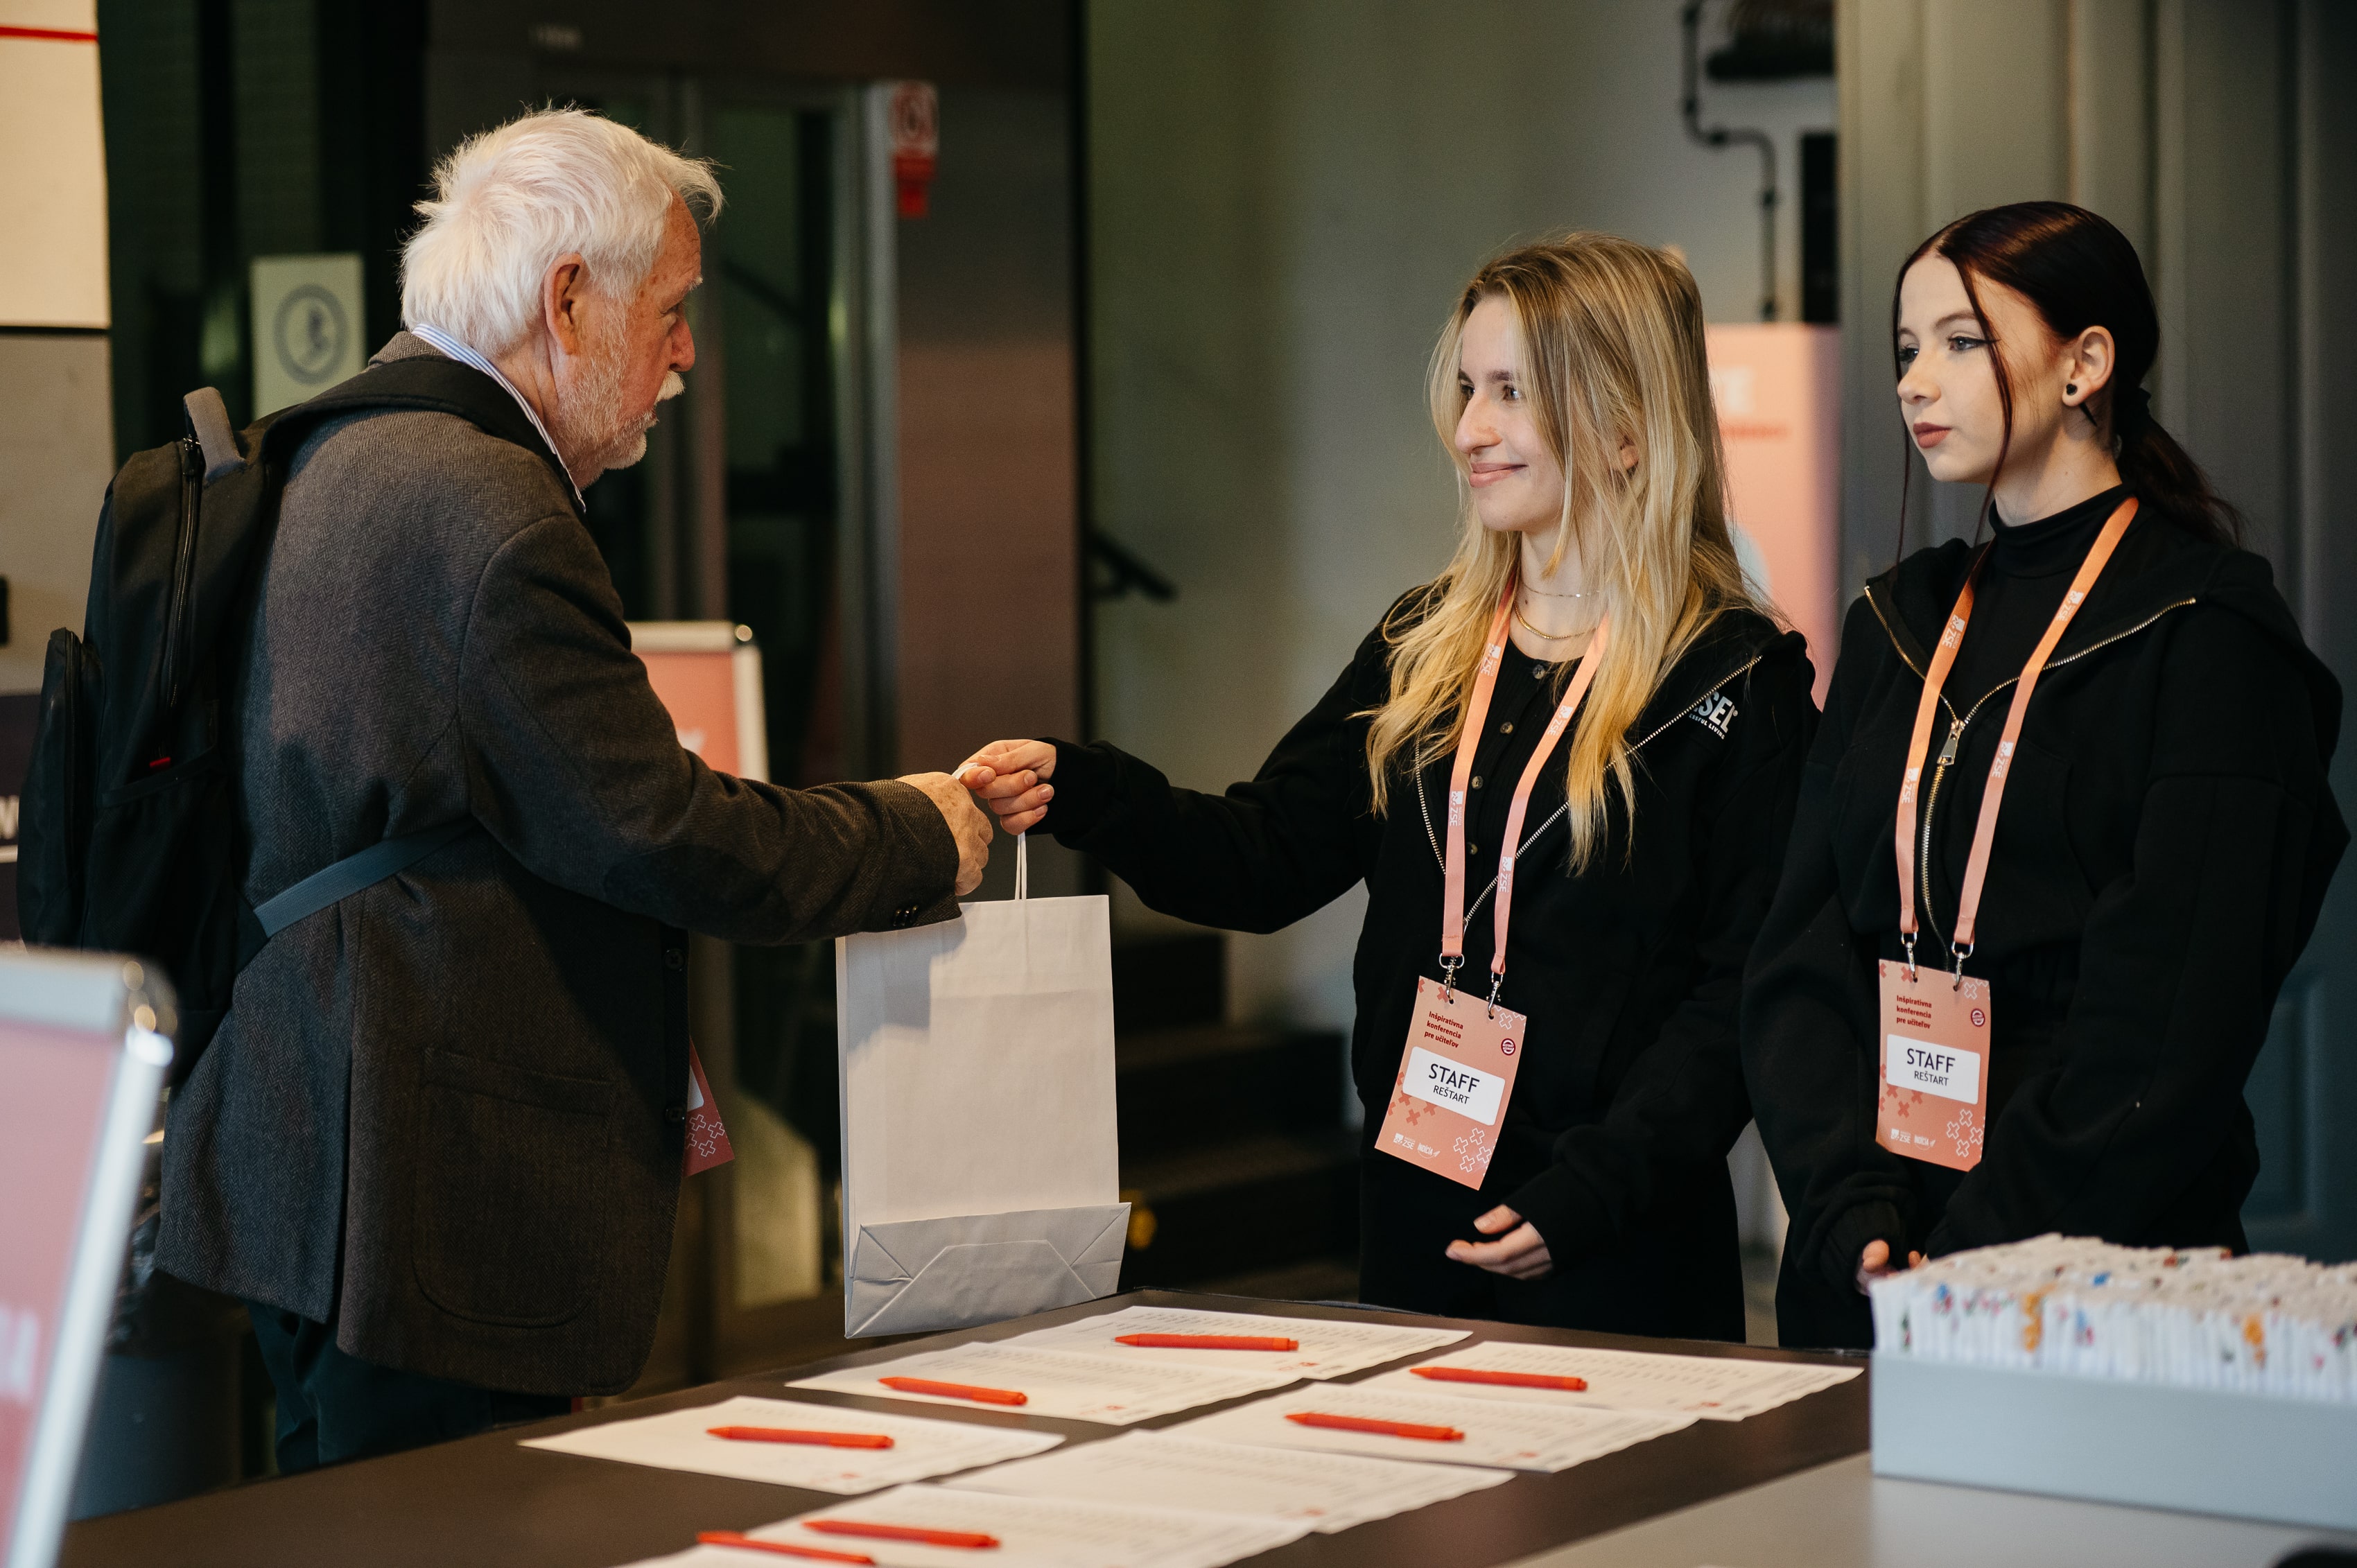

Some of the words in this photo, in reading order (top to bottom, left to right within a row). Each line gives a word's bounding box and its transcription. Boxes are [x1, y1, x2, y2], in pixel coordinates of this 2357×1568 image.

[1942, 627, 1956, 648] ZSE
[1480, 657, 1493, 677] ZSE
[1547, 718, 1563, 736] ZSE
[1708, 723, 1725, 740] LIVING
[1992, 758, 2005, 778] ZSE
[1901, 783, 1912, 804] ZSE
[1450, 807, 1458, 826] ZSE
[1499, 873, 1508, 893] ZSE
[1897, 1005, 1931, 1018] konferencia
[1427, 1020, 1461, 1039] konferencia
[1907, 1048, 1956, 1073] STAFF
[1429, 1063, 1480, 1092] STAFF
[1914, 1071, 1949, 1086] REŠTART
[1433, 1085, 1470, 1104] REŠTART
[1402, 1139, 1415, 1150] ZSE
[1899, 1134, 1911, 1144] ZSE
